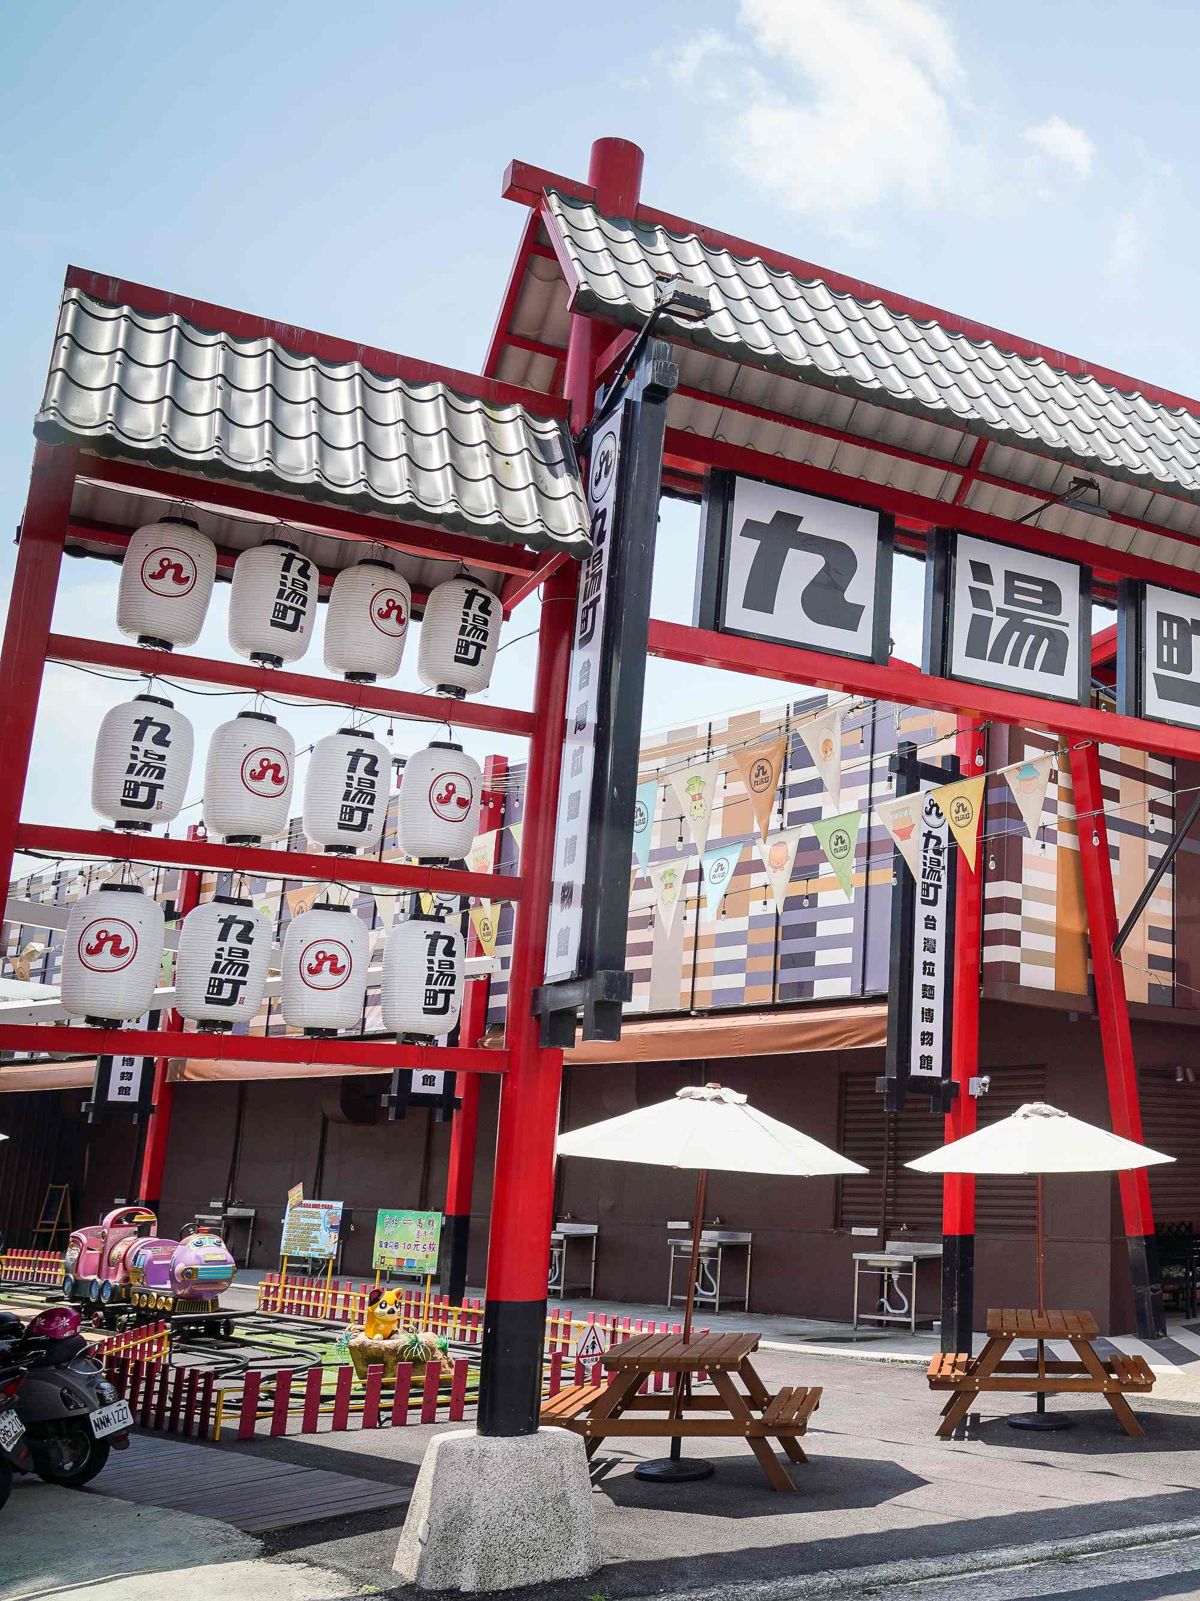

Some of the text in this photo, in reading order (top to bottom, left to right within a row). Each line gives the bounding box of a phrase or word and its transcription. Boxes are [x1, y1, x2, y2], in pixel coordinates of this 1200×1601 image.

[271, 549, 311, 632] 九湯町
[453, 586, 492, 667] 九湯町
[120, 715, 172, 810] 九湯町
[337, 748, 380, 833] 九湯町
[204, 913, 256, 1007] 九湯町
[422, 930, 457, 1016] 九湯町
[918, 830, 945, 1072] 九湯町 台灣拉麵博物館
